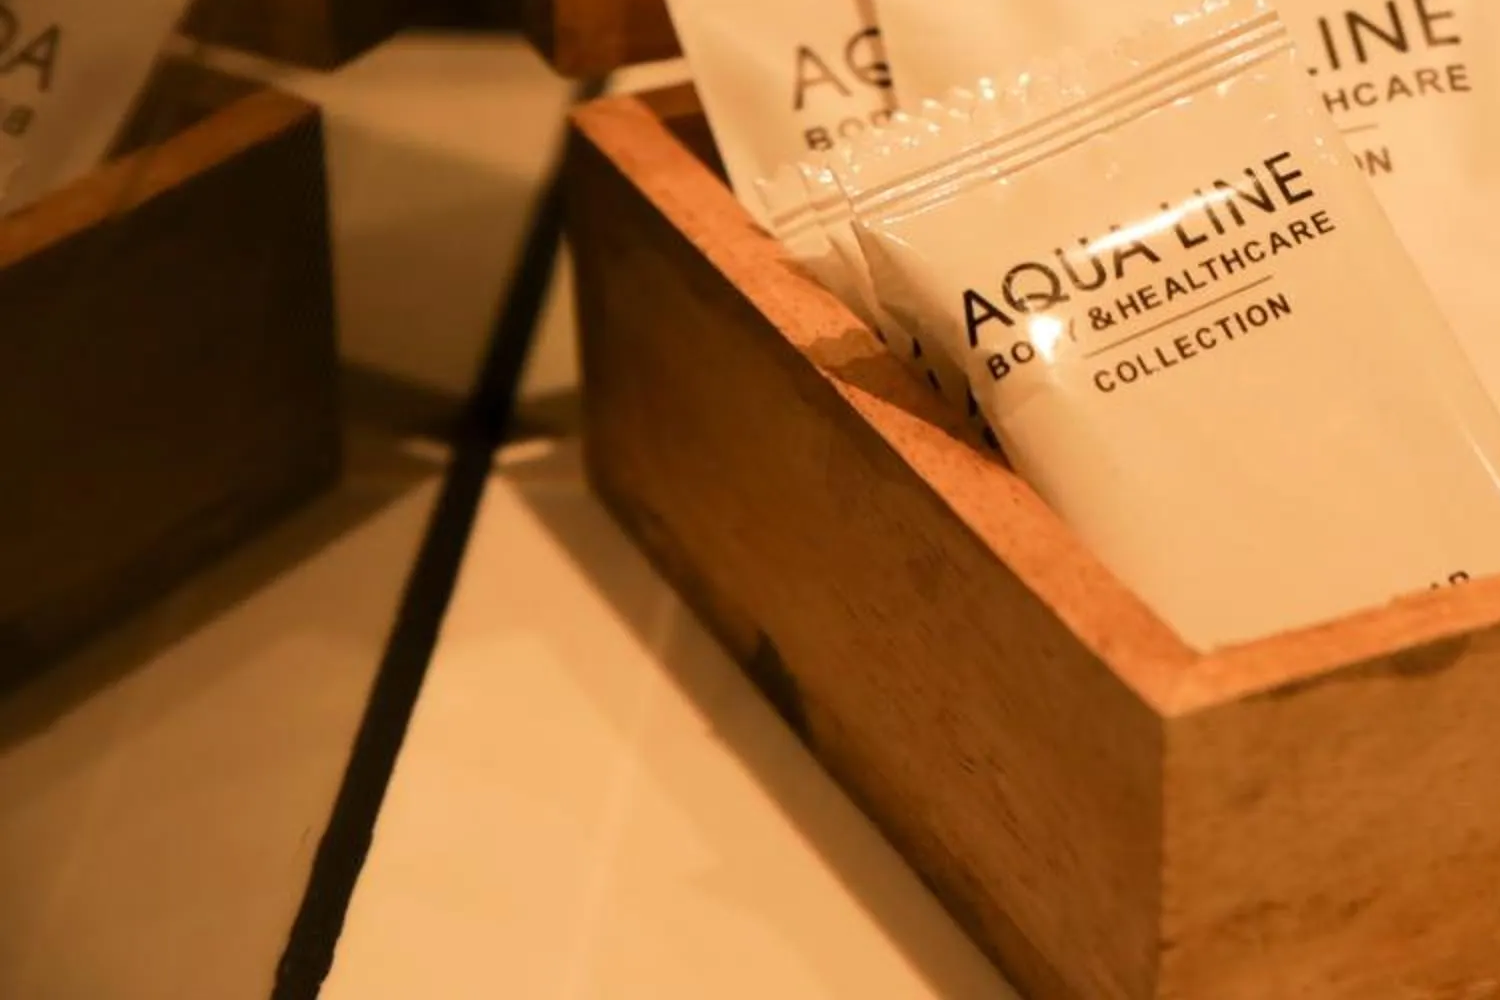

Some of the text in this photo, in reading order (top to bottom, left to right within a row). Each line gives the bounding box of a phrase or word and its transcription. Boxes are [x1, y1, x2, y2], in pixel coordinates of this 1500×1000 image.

[1321, 63, 1473, 115] HCARE
[961, 150, 1314, 350] AQUA LINE
[1092, 292, 1293, 395] COLLECTION
